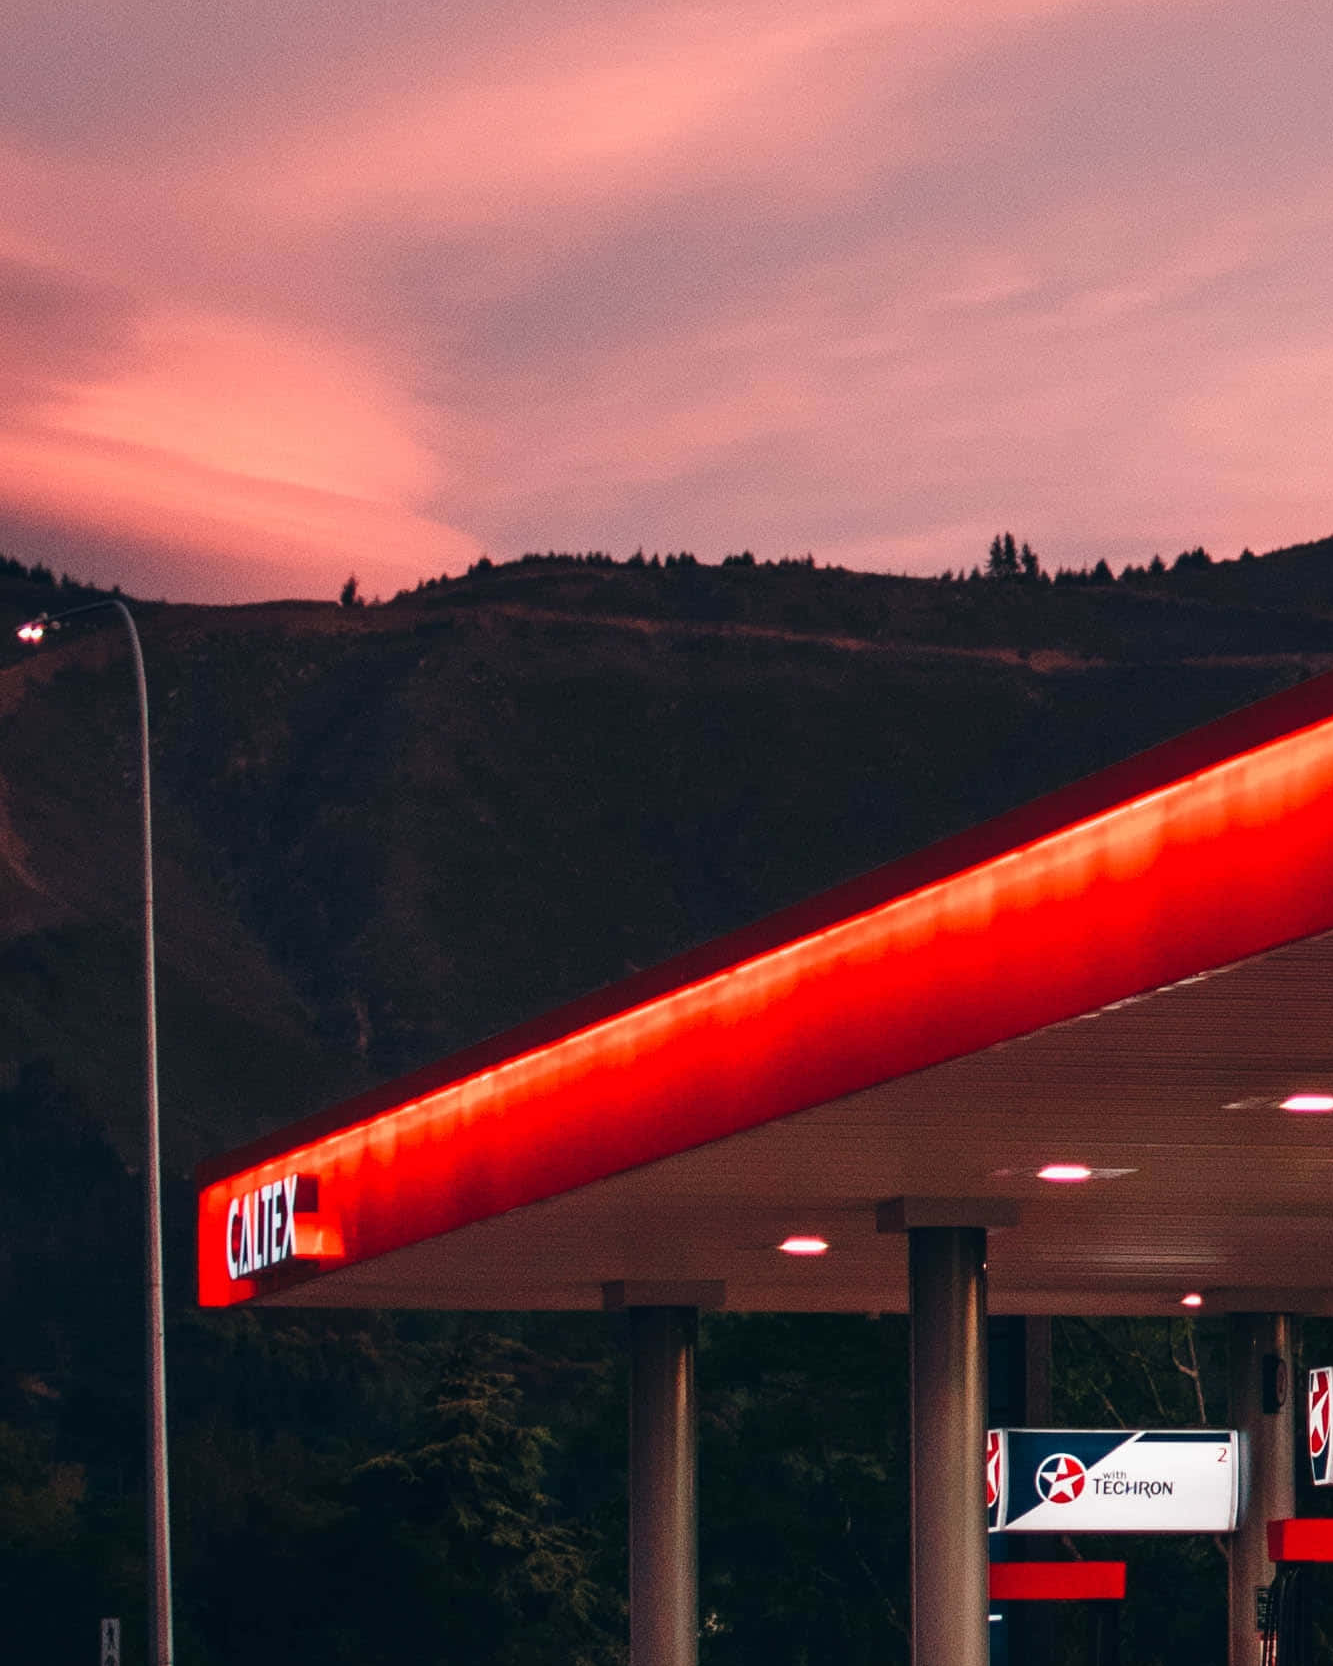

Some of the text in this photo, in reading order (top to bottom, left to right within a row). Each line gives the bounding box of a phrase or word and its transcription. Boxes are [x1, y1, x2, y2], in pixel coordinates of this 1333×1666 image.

[226, 1173, 299, 1280] CALTEX
[1216, 1447, 1227, 1463] 2
[1102, 1470, 1127, 1480] with
[1093, 1478, 1174, 1499] TECHRON
